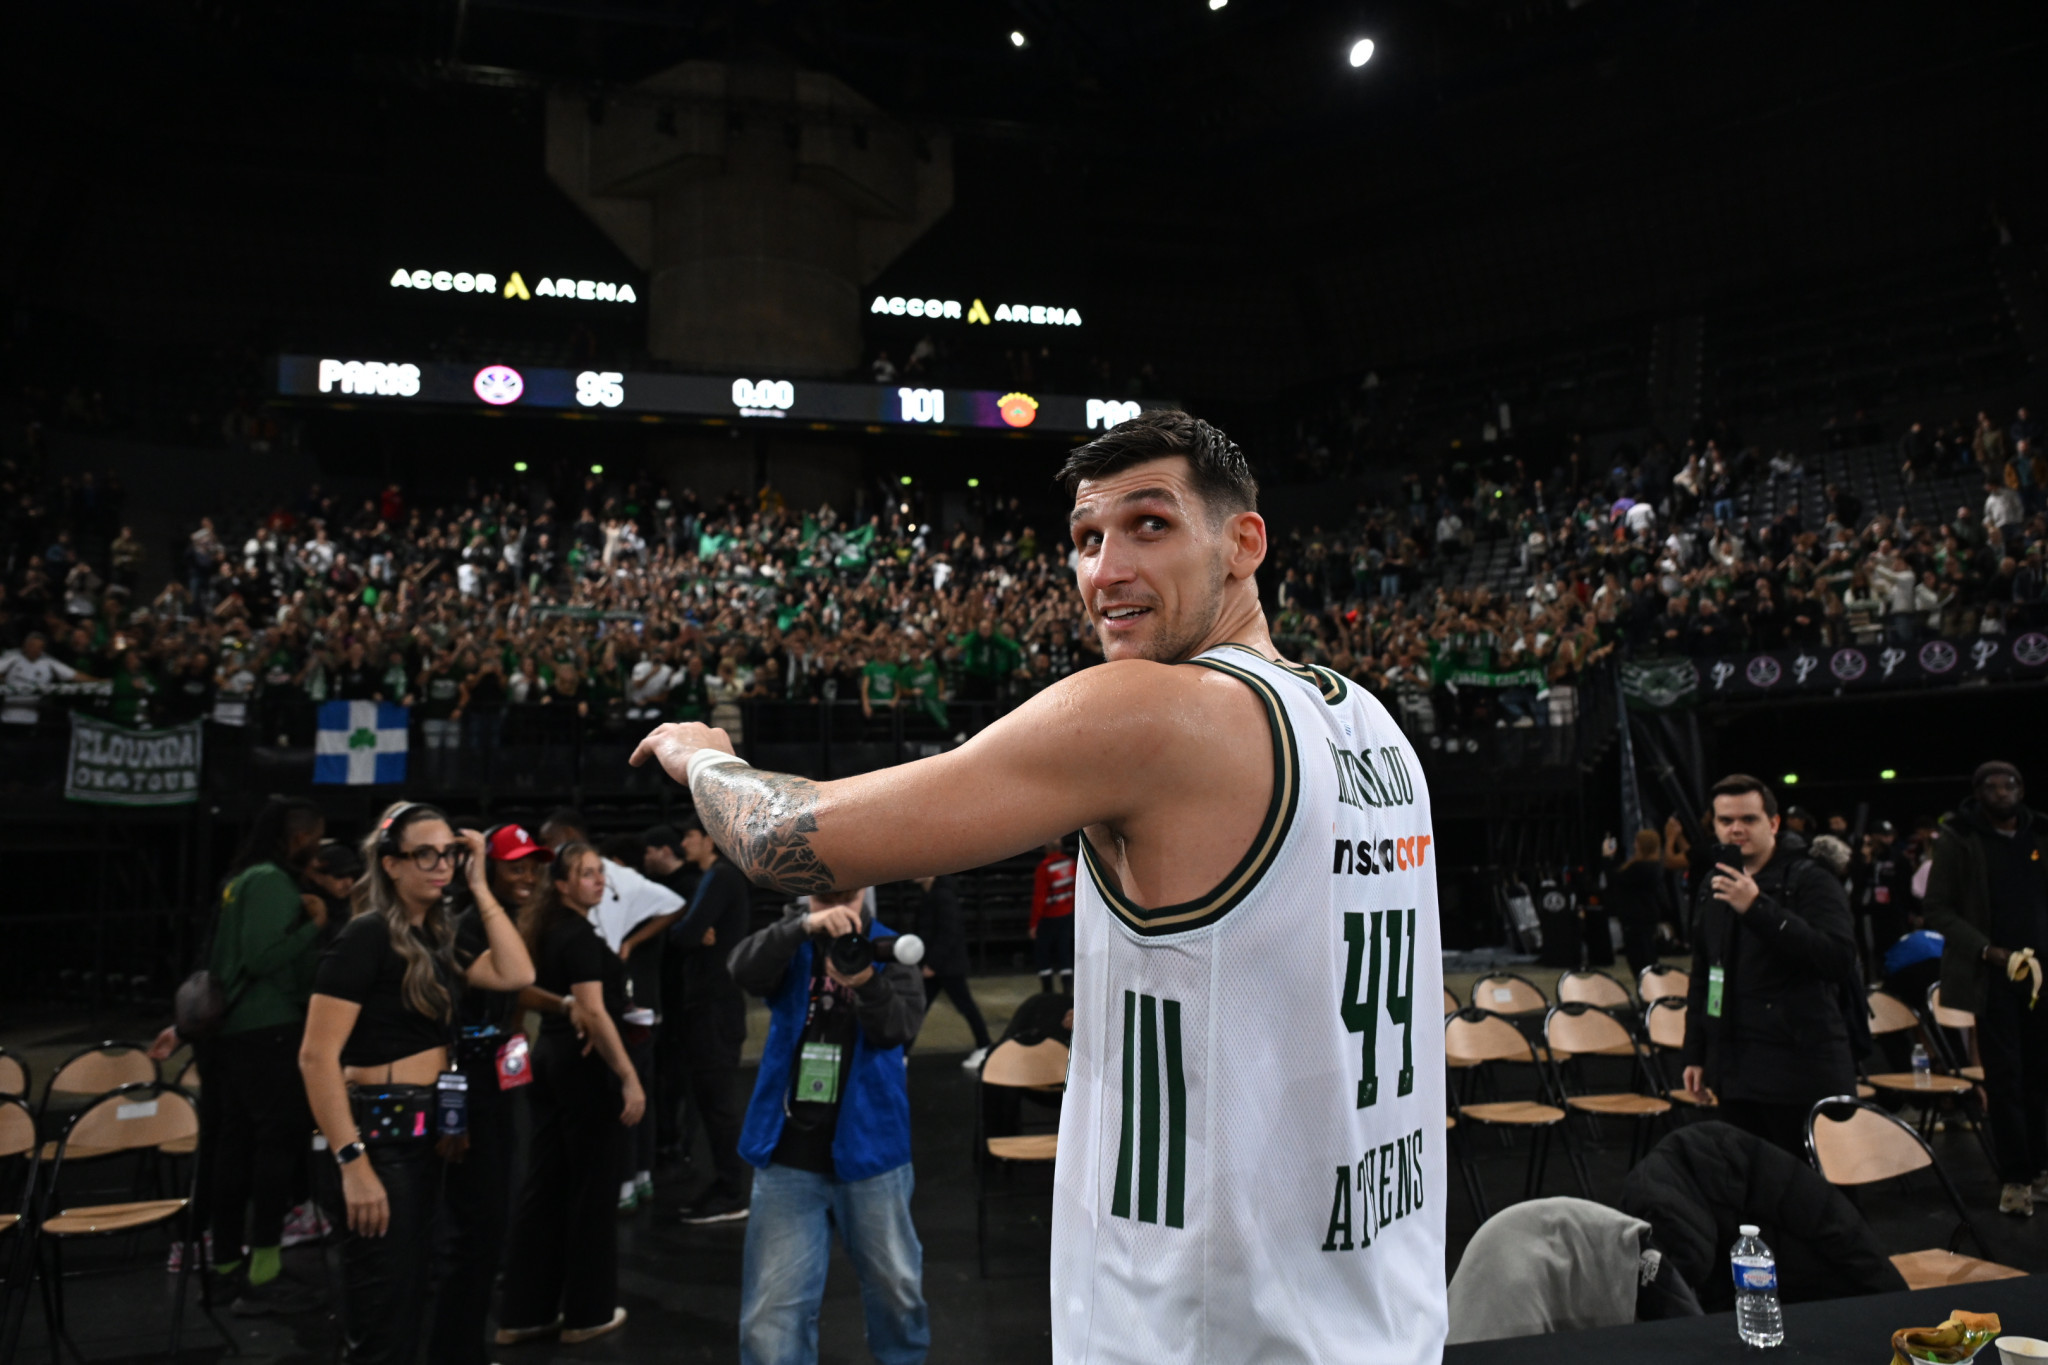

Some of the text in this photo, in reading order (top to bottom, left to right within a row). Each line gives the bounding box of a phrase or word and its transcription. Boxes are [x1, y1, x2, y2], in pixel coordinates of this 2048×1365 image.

[391, 268, 497, 294] ACCOR
[535, 277, 637, 304] ARENA
[870, 295, 962, 320] ACCOR
[994, 303, 1082, 327] ARENA
[318, 358, 421, 397] PARIS
[897, 387, 945, 424] 101
[1340, 908, 1416, 1110] 44
[1321, 1127, 1424, 1252] ATHENS
